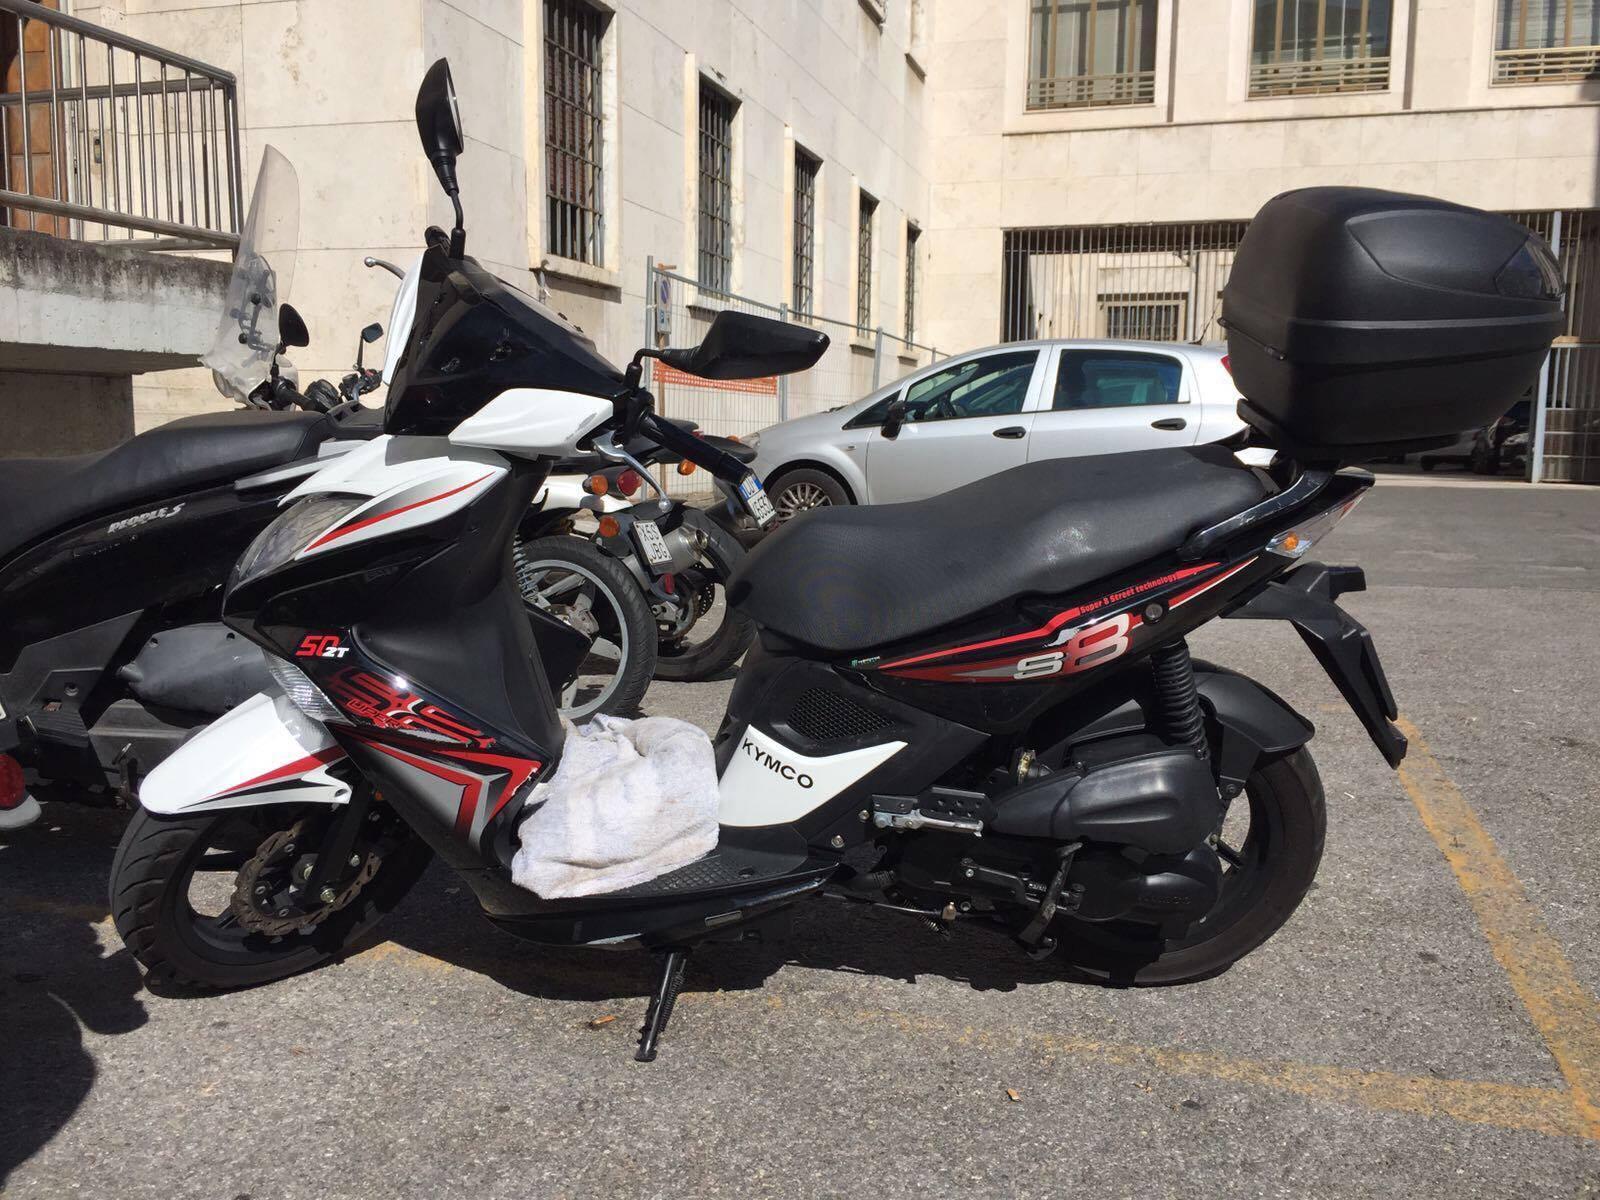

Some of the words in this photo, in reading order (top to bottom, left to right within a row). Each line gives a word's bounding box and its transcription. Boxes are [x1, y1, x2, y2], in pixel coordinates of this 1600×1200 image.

[1109, 587, 1135, 602] Street
[1135, 574, 1177, 593] technology
[295, 635, 340, 657] 50
[322, 646, 350, 658] 2T
[742, 738, 814, 789] KYMCO
